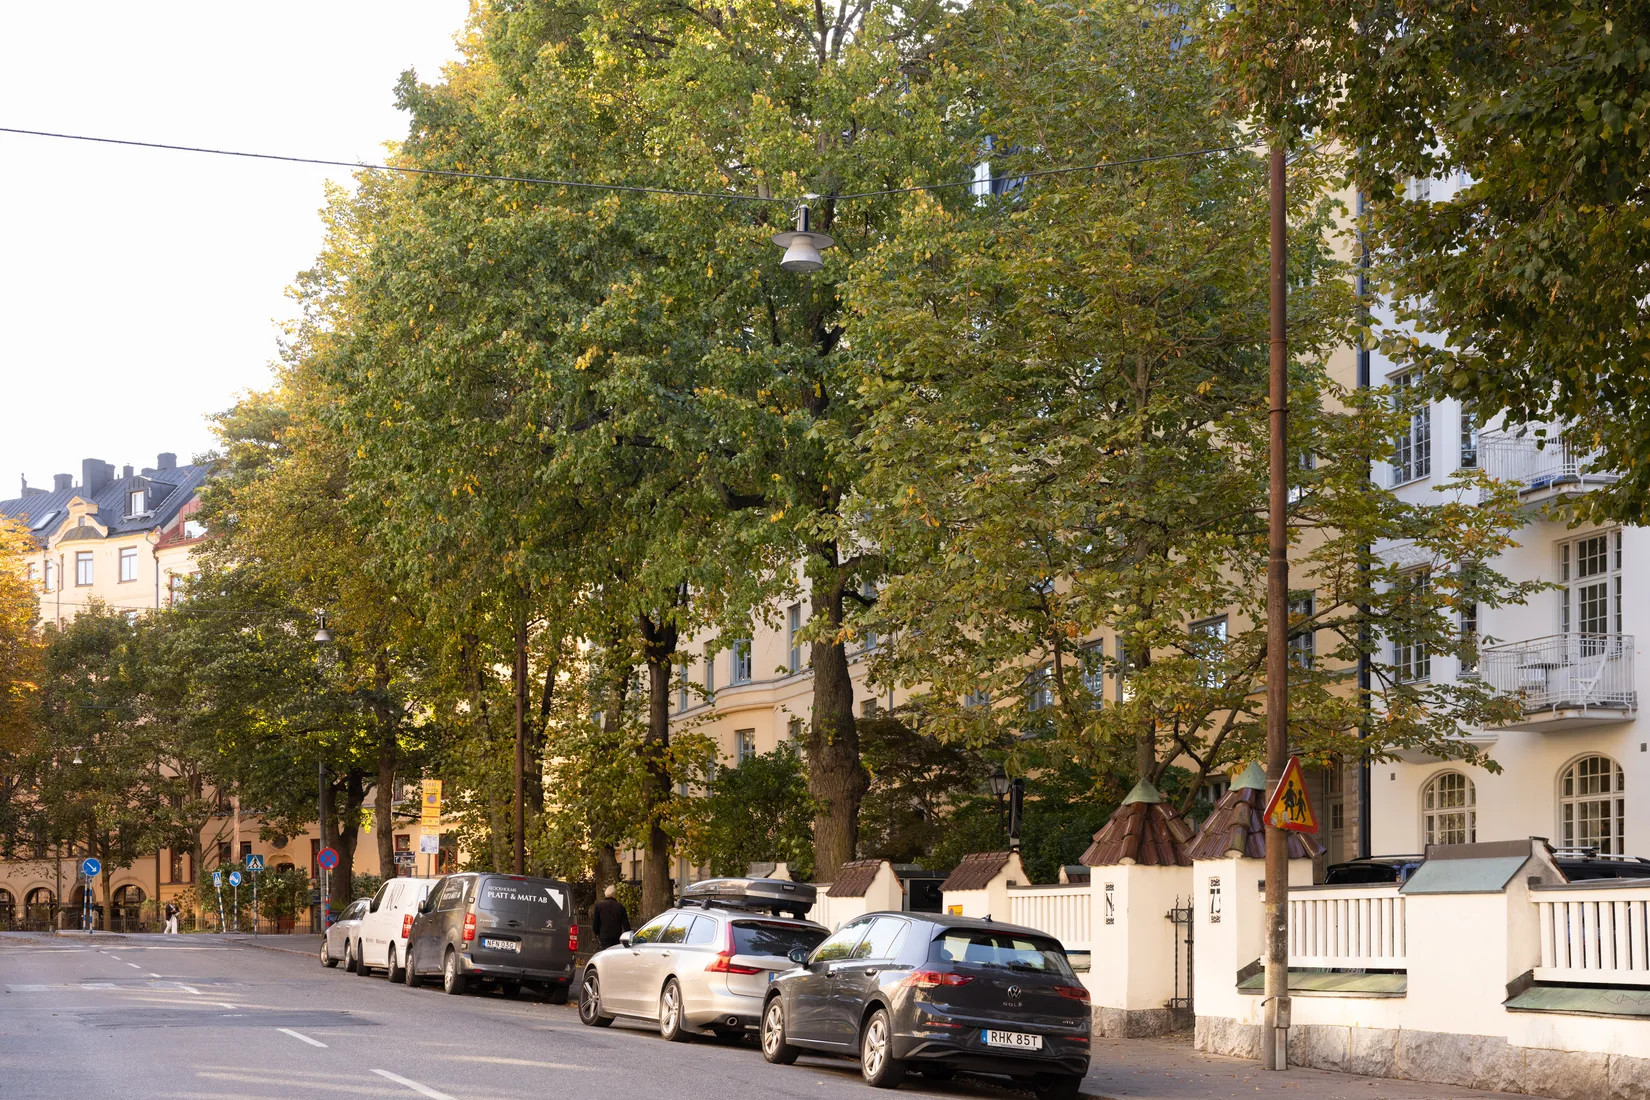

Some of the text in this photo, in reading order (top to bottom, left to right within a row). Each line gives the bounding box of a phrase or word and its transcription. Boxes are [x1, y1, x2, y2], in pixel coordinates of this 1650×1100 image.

[487, 891, 508, 899] PLATT
[991, 1031, 1037, 1046] RHK 85T
